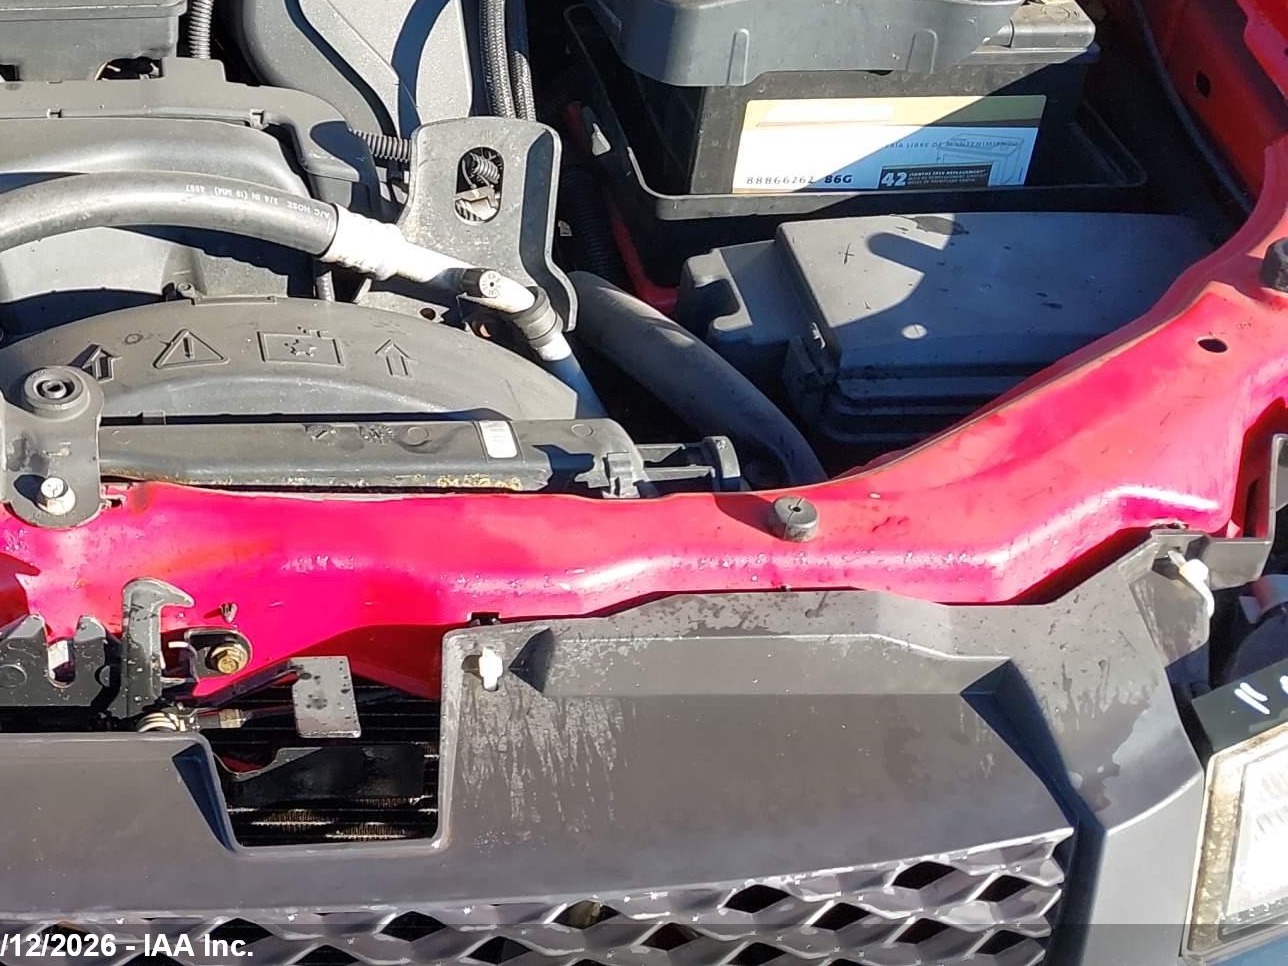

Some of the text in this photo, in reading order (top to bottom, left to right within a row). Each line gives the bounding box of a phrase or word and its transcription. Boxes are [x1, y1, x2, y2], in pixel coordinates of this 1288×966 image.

[823, 174, 853, 184] 86G
[881, 171, 906, 187] 42
[287, 200, 311, 214] HOSE
